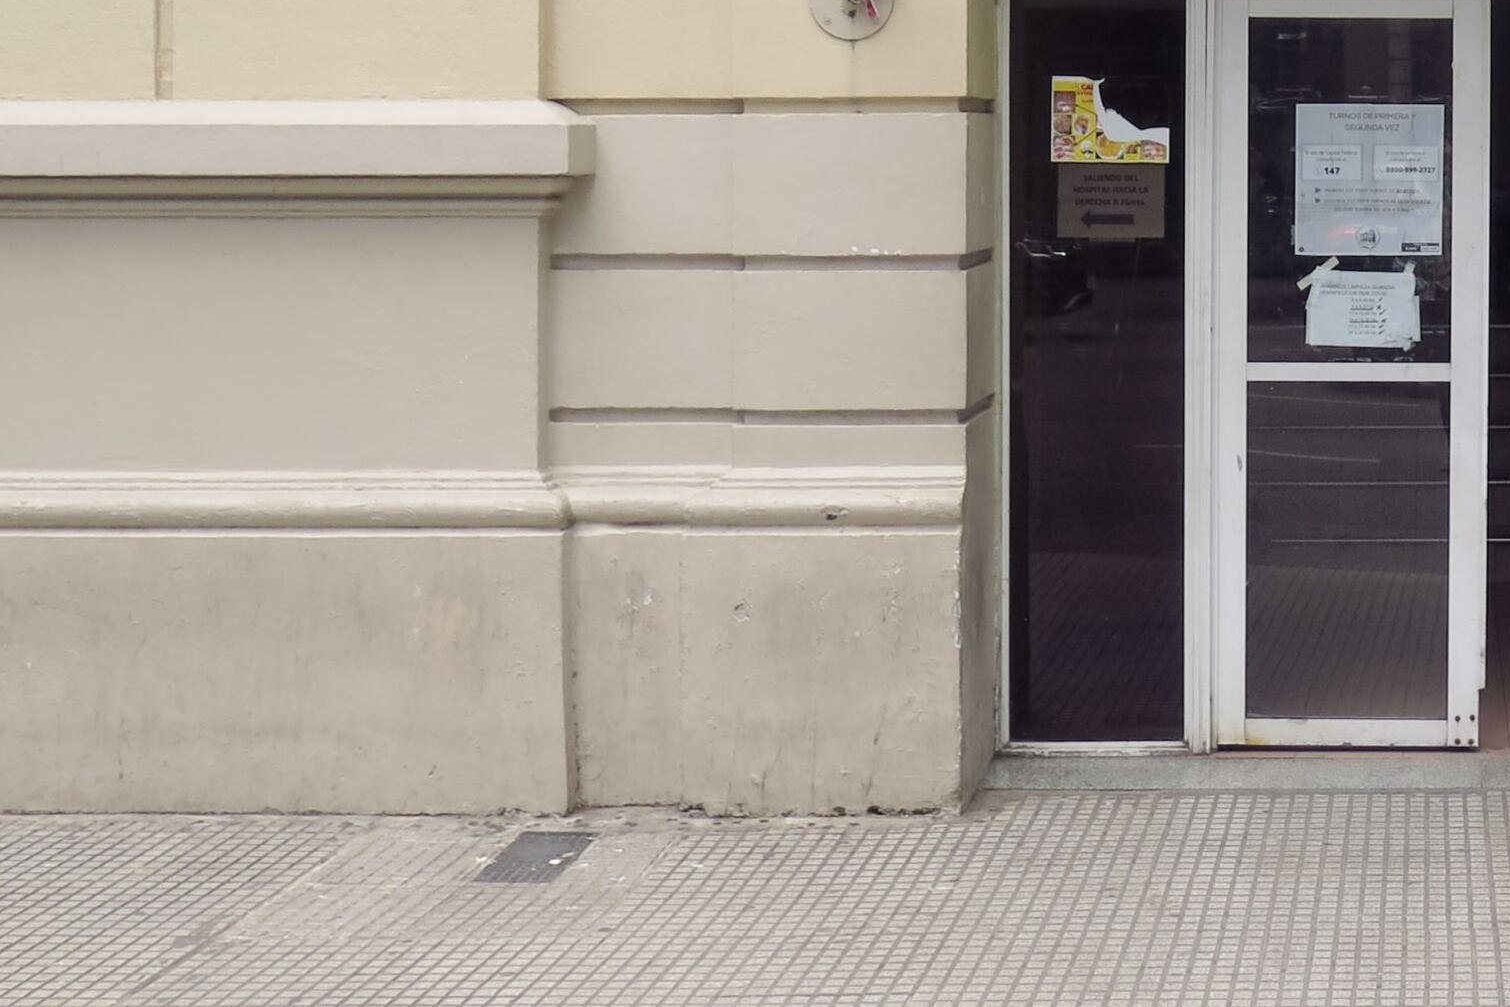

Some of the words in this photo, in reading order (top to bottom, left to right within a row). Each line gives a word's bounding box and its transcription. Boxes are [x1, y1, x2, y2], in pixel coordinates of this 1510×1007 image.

[1329, 112, 1362, 120] TURNOS
[1362, 112, 1374, 120] DE
[1374, 112, 1409, 120] PRIMERA
[1345, 123, 1384, 131] SEGUNDA
[1324, 166, 1341, 175] 147
